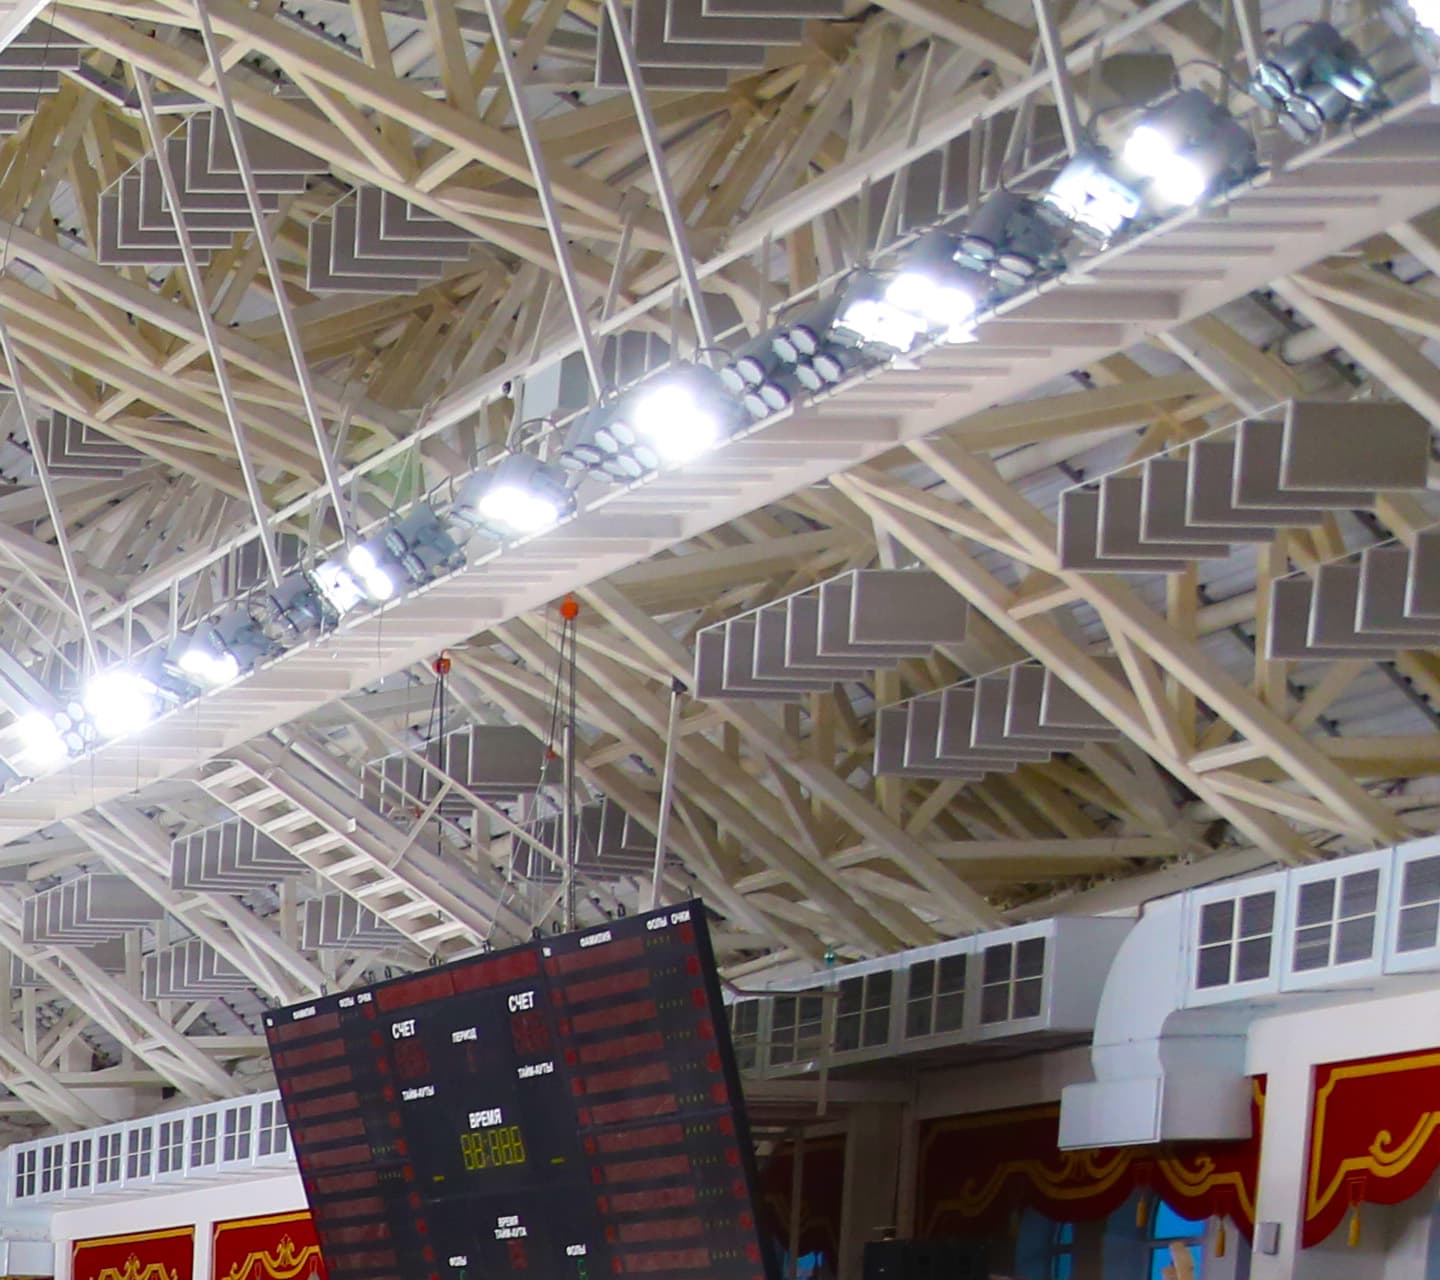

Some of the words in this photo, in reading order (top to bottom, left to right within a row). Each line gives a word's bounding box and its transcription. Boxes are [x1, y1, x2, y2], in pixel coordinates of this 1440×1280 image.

[508, 991, 534, 1013] СЧЕТ
[391, 1019, 415, 1040] СЧЕТ
[468, 1108, 502, 1129] ВРЕМЯ
